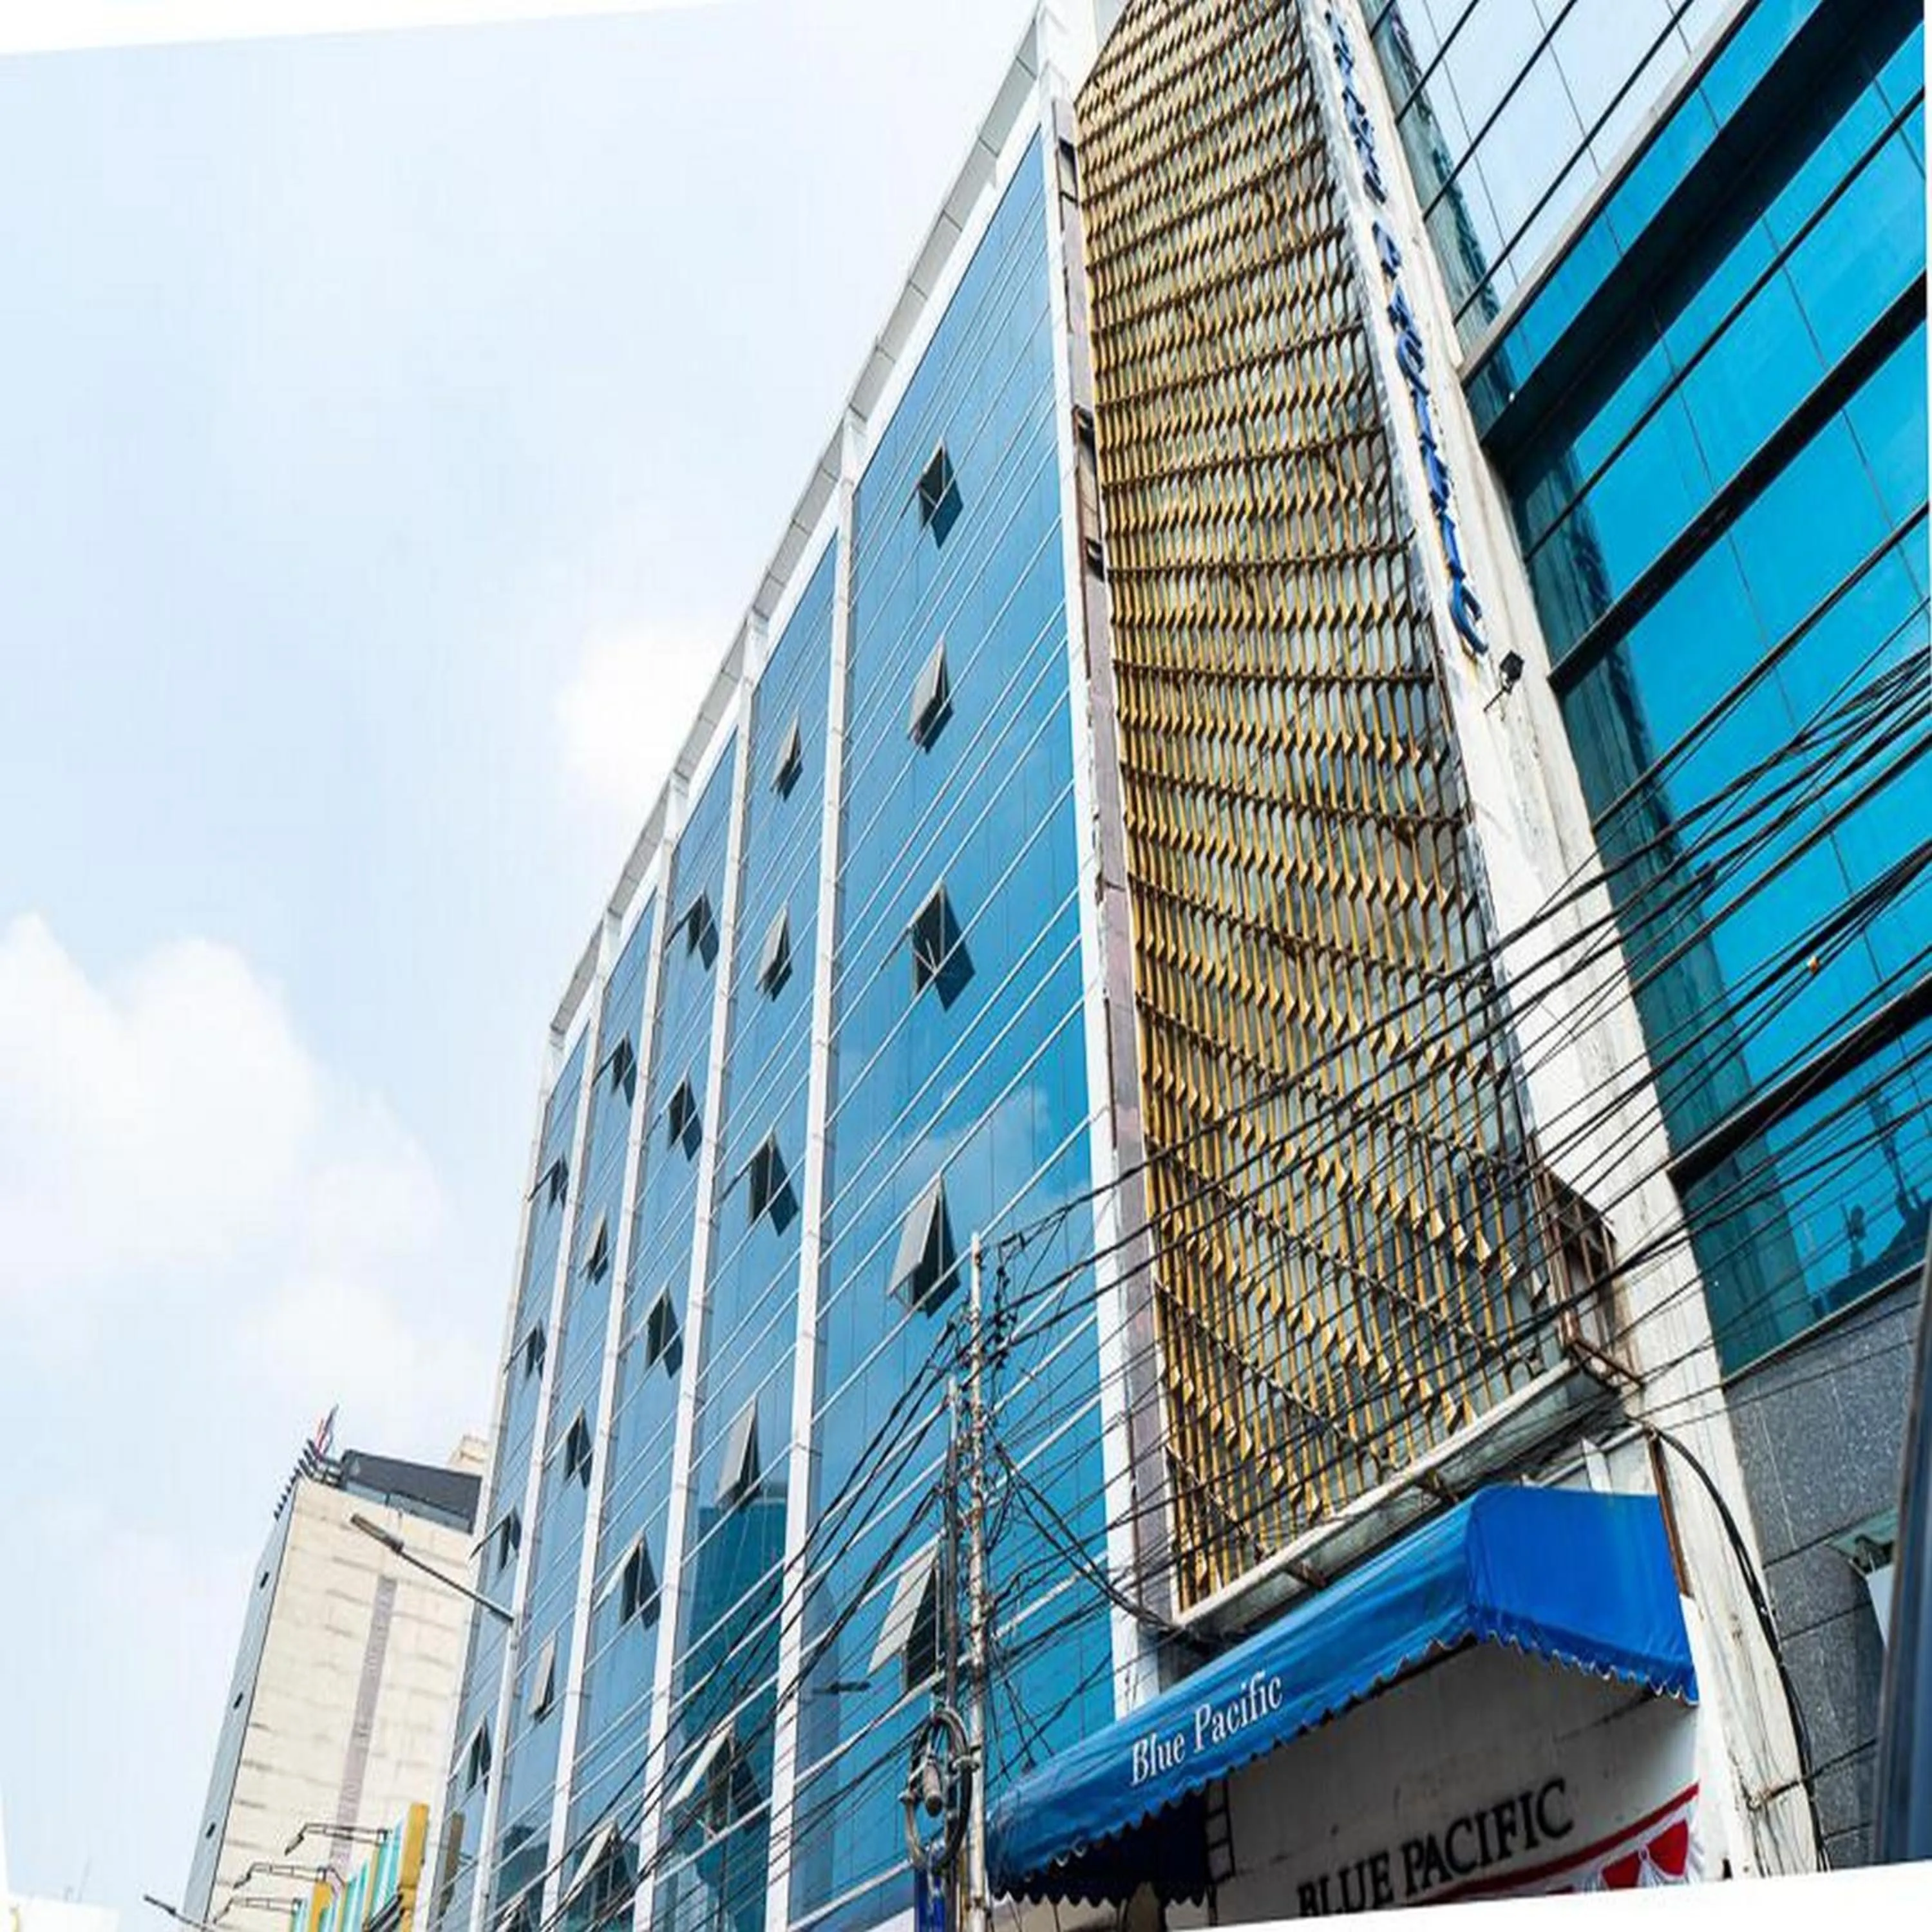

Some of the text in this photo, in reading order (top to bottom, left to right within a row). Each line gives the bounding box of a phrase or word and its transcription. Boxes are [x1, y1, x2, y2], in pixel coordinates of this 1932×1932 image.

[1372, 220, 1488, 653] PACIFIC
[1130, 1671, 1283, 1787] Blue Pacific
[1296, 1777, 1575, 1917] BLUE PACIFIC
